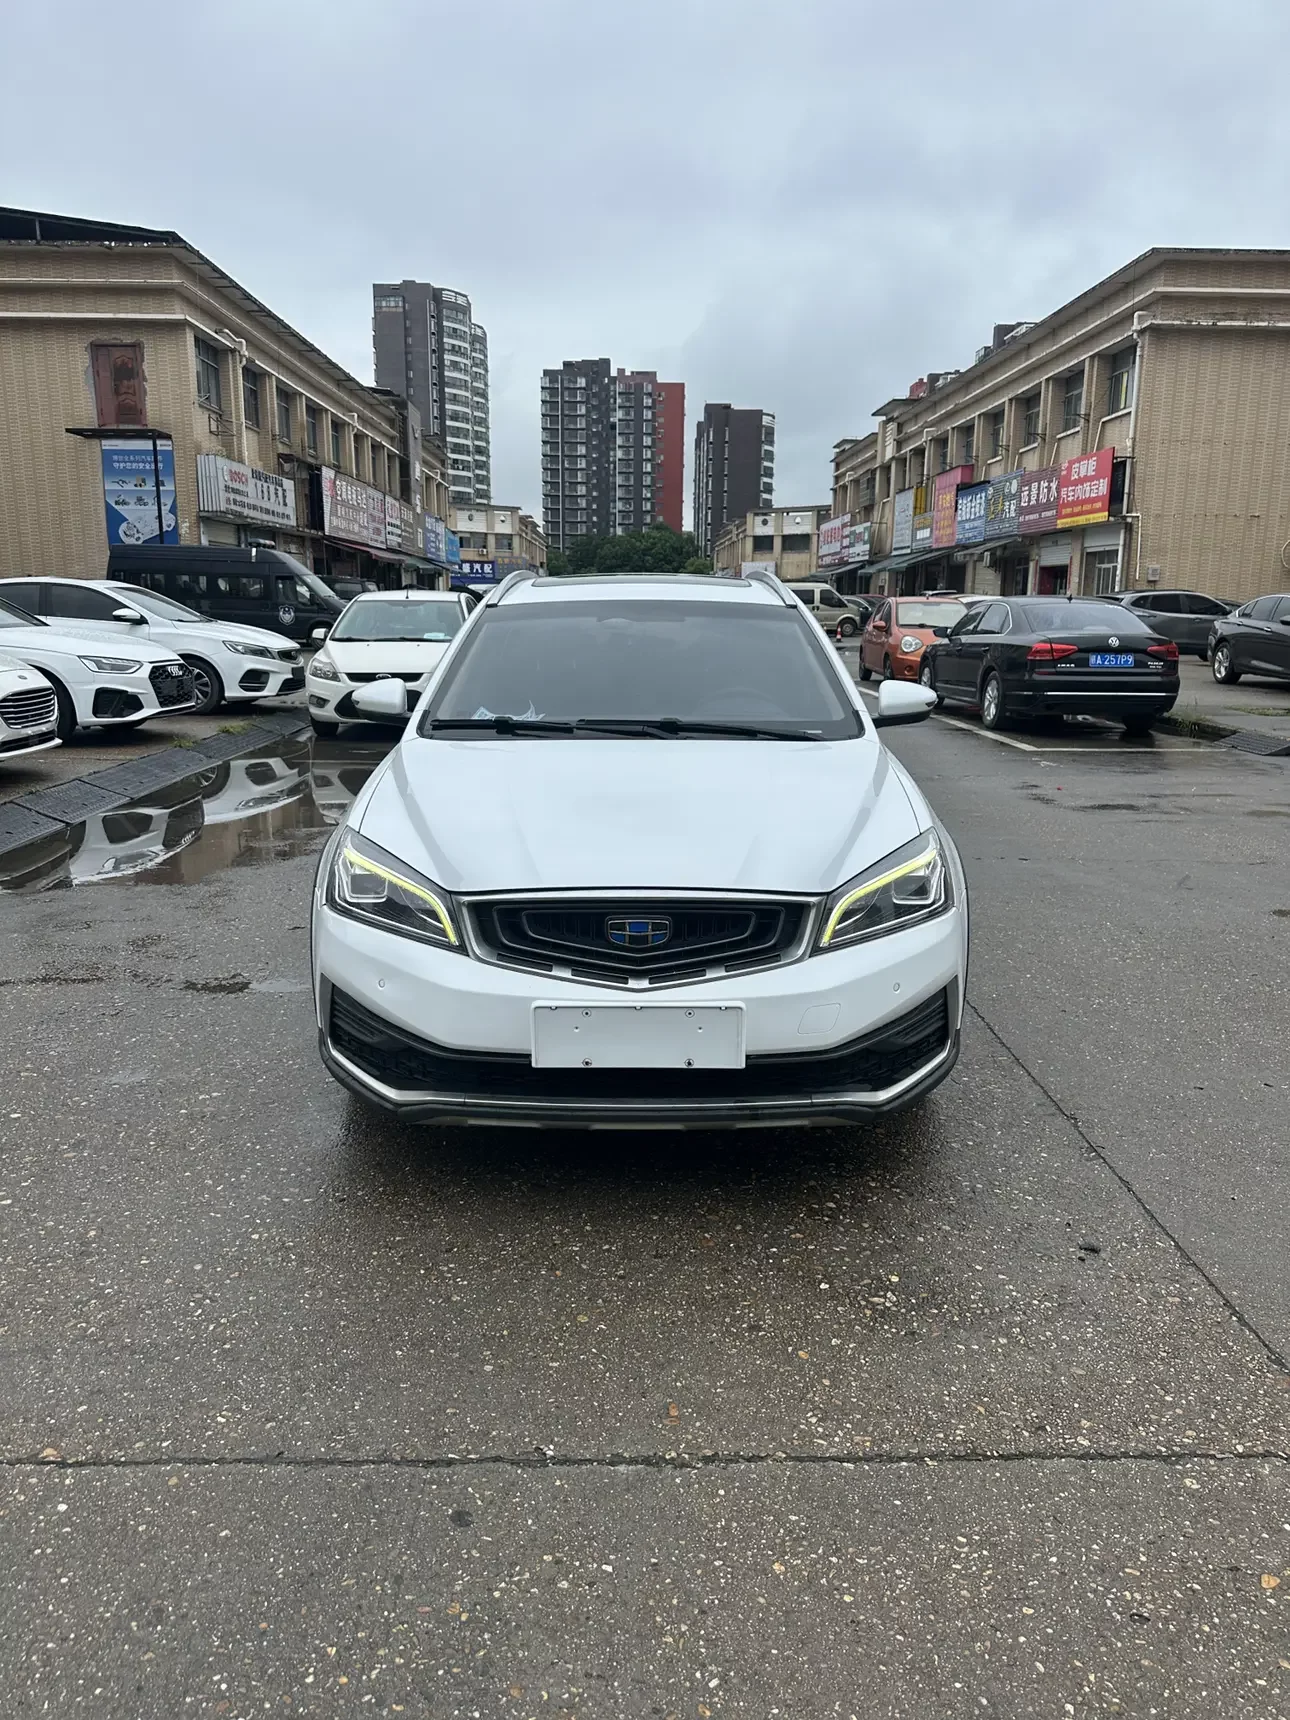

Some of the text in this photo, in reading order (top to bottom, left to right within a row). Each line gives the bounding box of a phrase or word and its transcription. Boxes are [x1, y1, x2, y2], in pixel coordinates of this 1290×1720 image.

[229, 469, 249, 486] BOSCH
[1070, 457, 1097, 480] 皮掌柜
[1020, 477, 1058, 507] 远景防水
[1060, 478, 1108, 504] 汽车内饰定制
